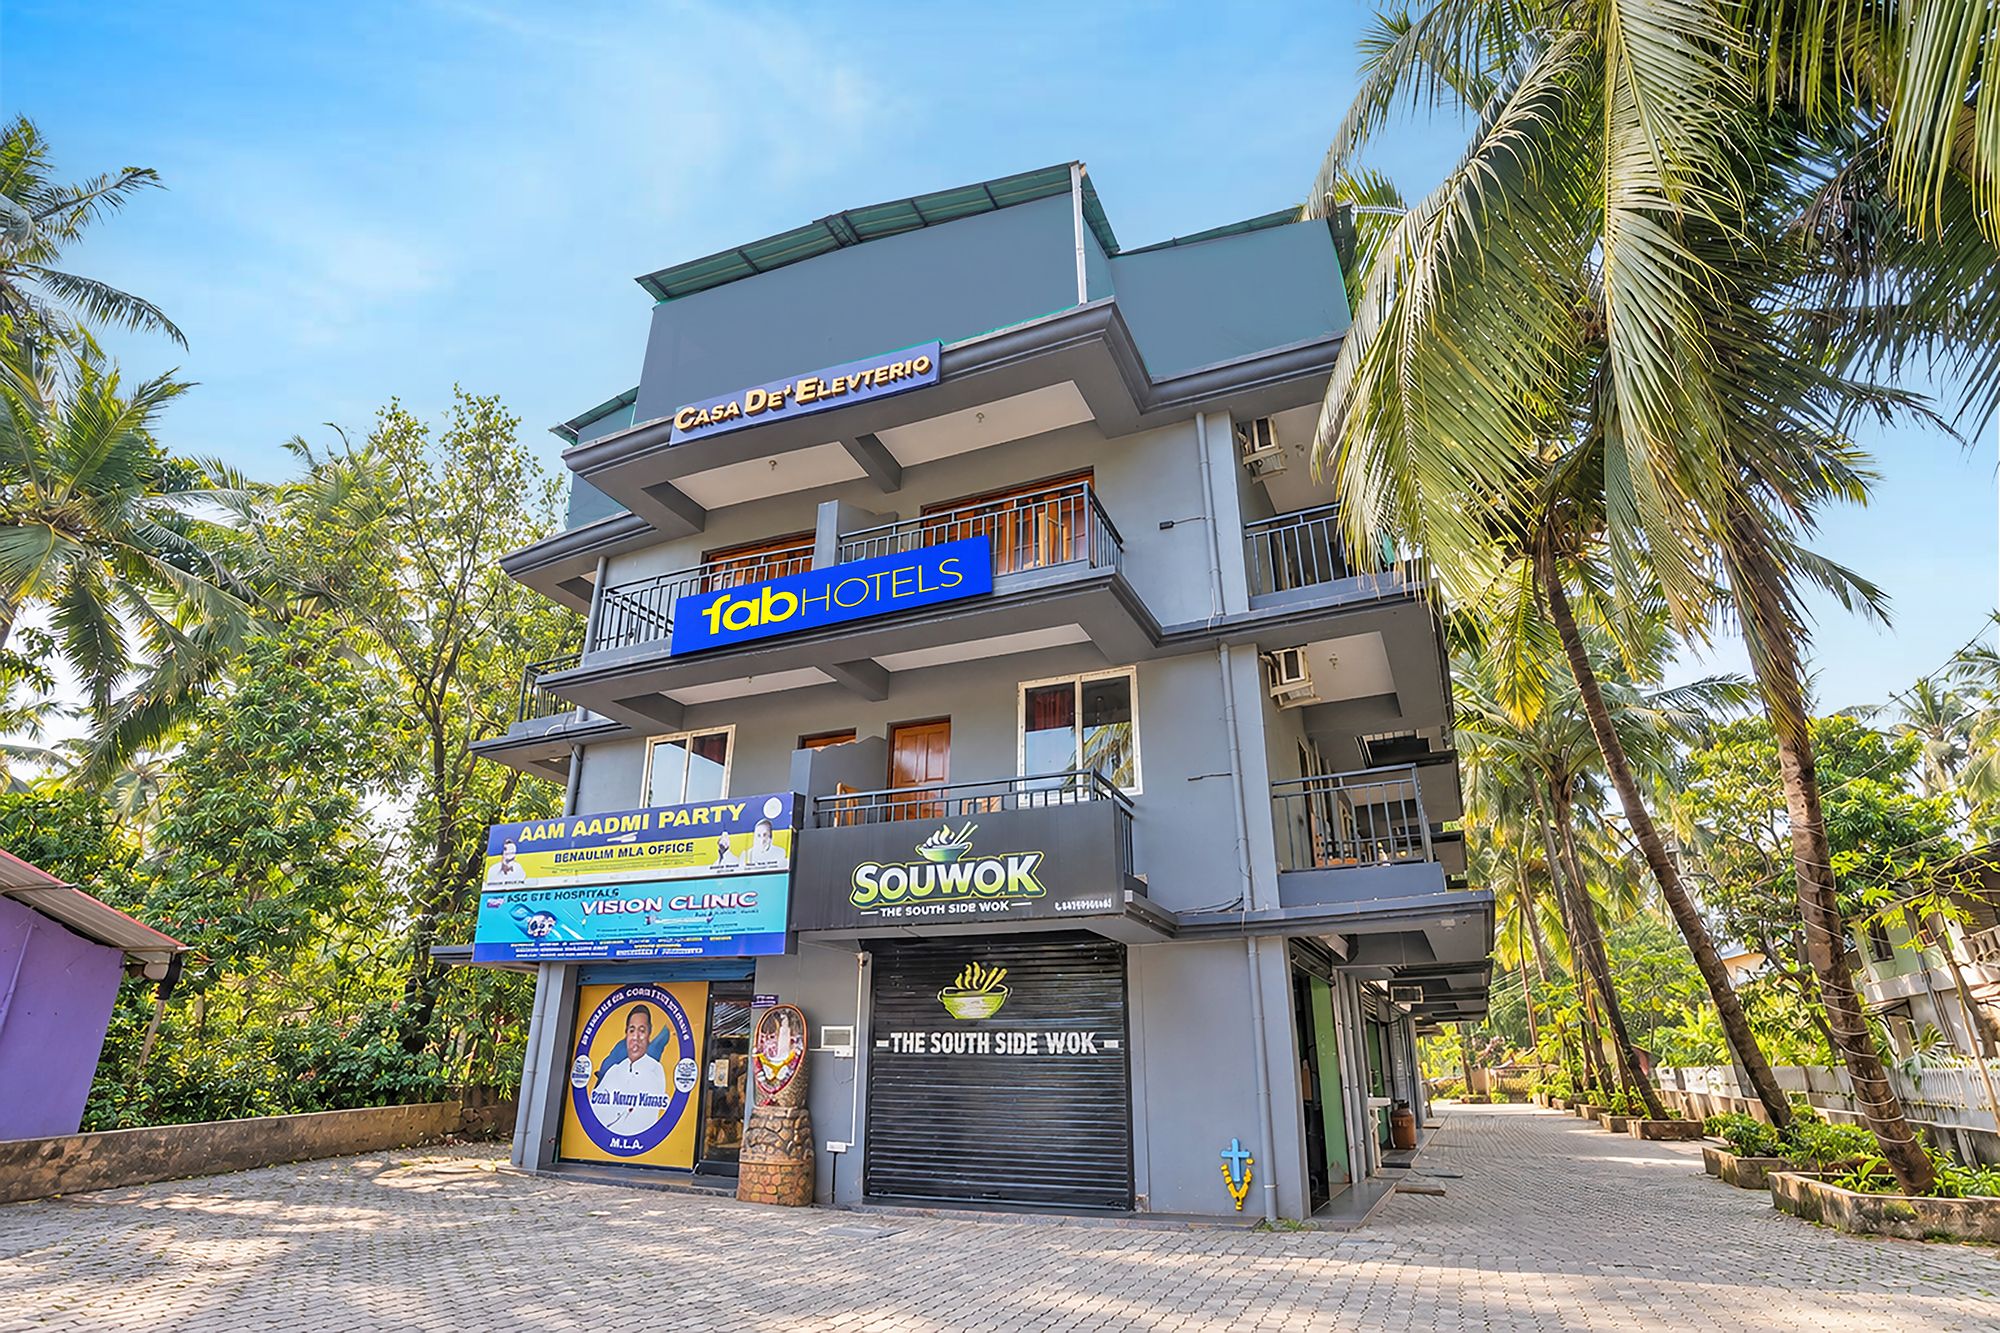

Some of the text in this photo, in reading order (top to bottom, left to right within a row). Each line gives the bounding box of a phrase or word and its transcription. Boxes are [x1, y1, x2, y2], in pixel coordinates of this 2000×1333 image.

[674, 399, 741, 432] CASA
[518, 802, 748, 844] AAM AADMI PARTY
[554, 841, 695, 864] BENAULIM MLA OFFICE
[853, 853, 1043, 905] SOUWOK
[554, 887, 620, 901] HOSPITALS
[581, 890, 759, 916] VISION CLINIC
[880, 899, 1012, 918] THE SOUTH SIDE WOK
[889, 1031, 1099, 1056] THE SOUTH SIDE WOK
